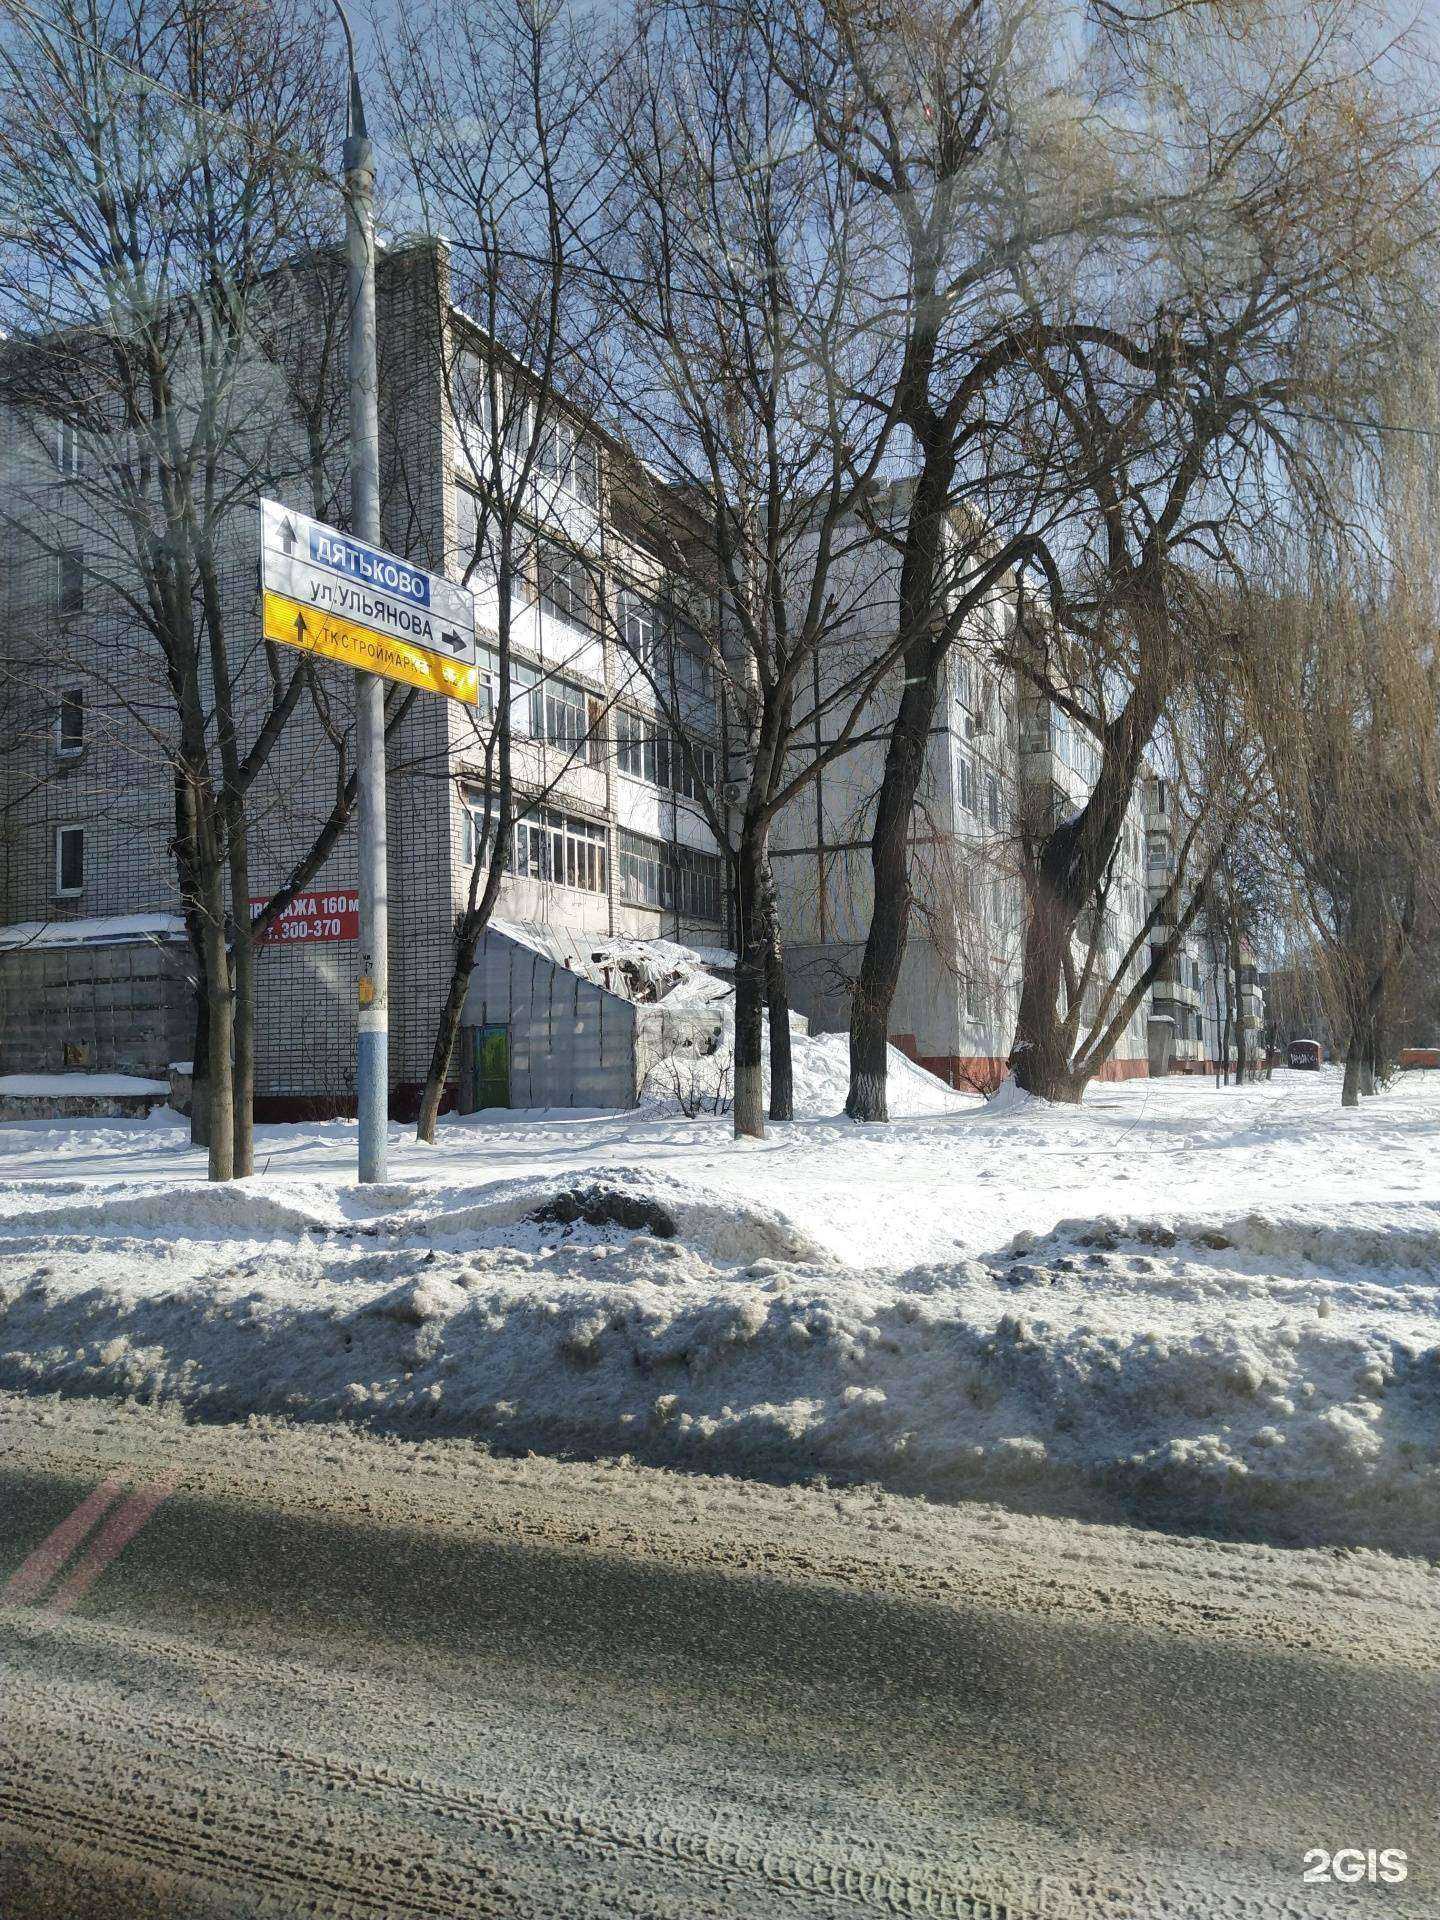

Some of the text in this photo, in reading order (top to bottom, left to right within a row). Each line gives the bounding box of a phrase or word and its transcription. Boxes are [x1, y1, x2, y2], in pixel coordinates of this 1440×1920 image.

[317, 537, 425, 599] ДЯТЬКОВО
[250, 898, 317, 920] ПРАЖА
[281, 918, 341, 939] 300-370
